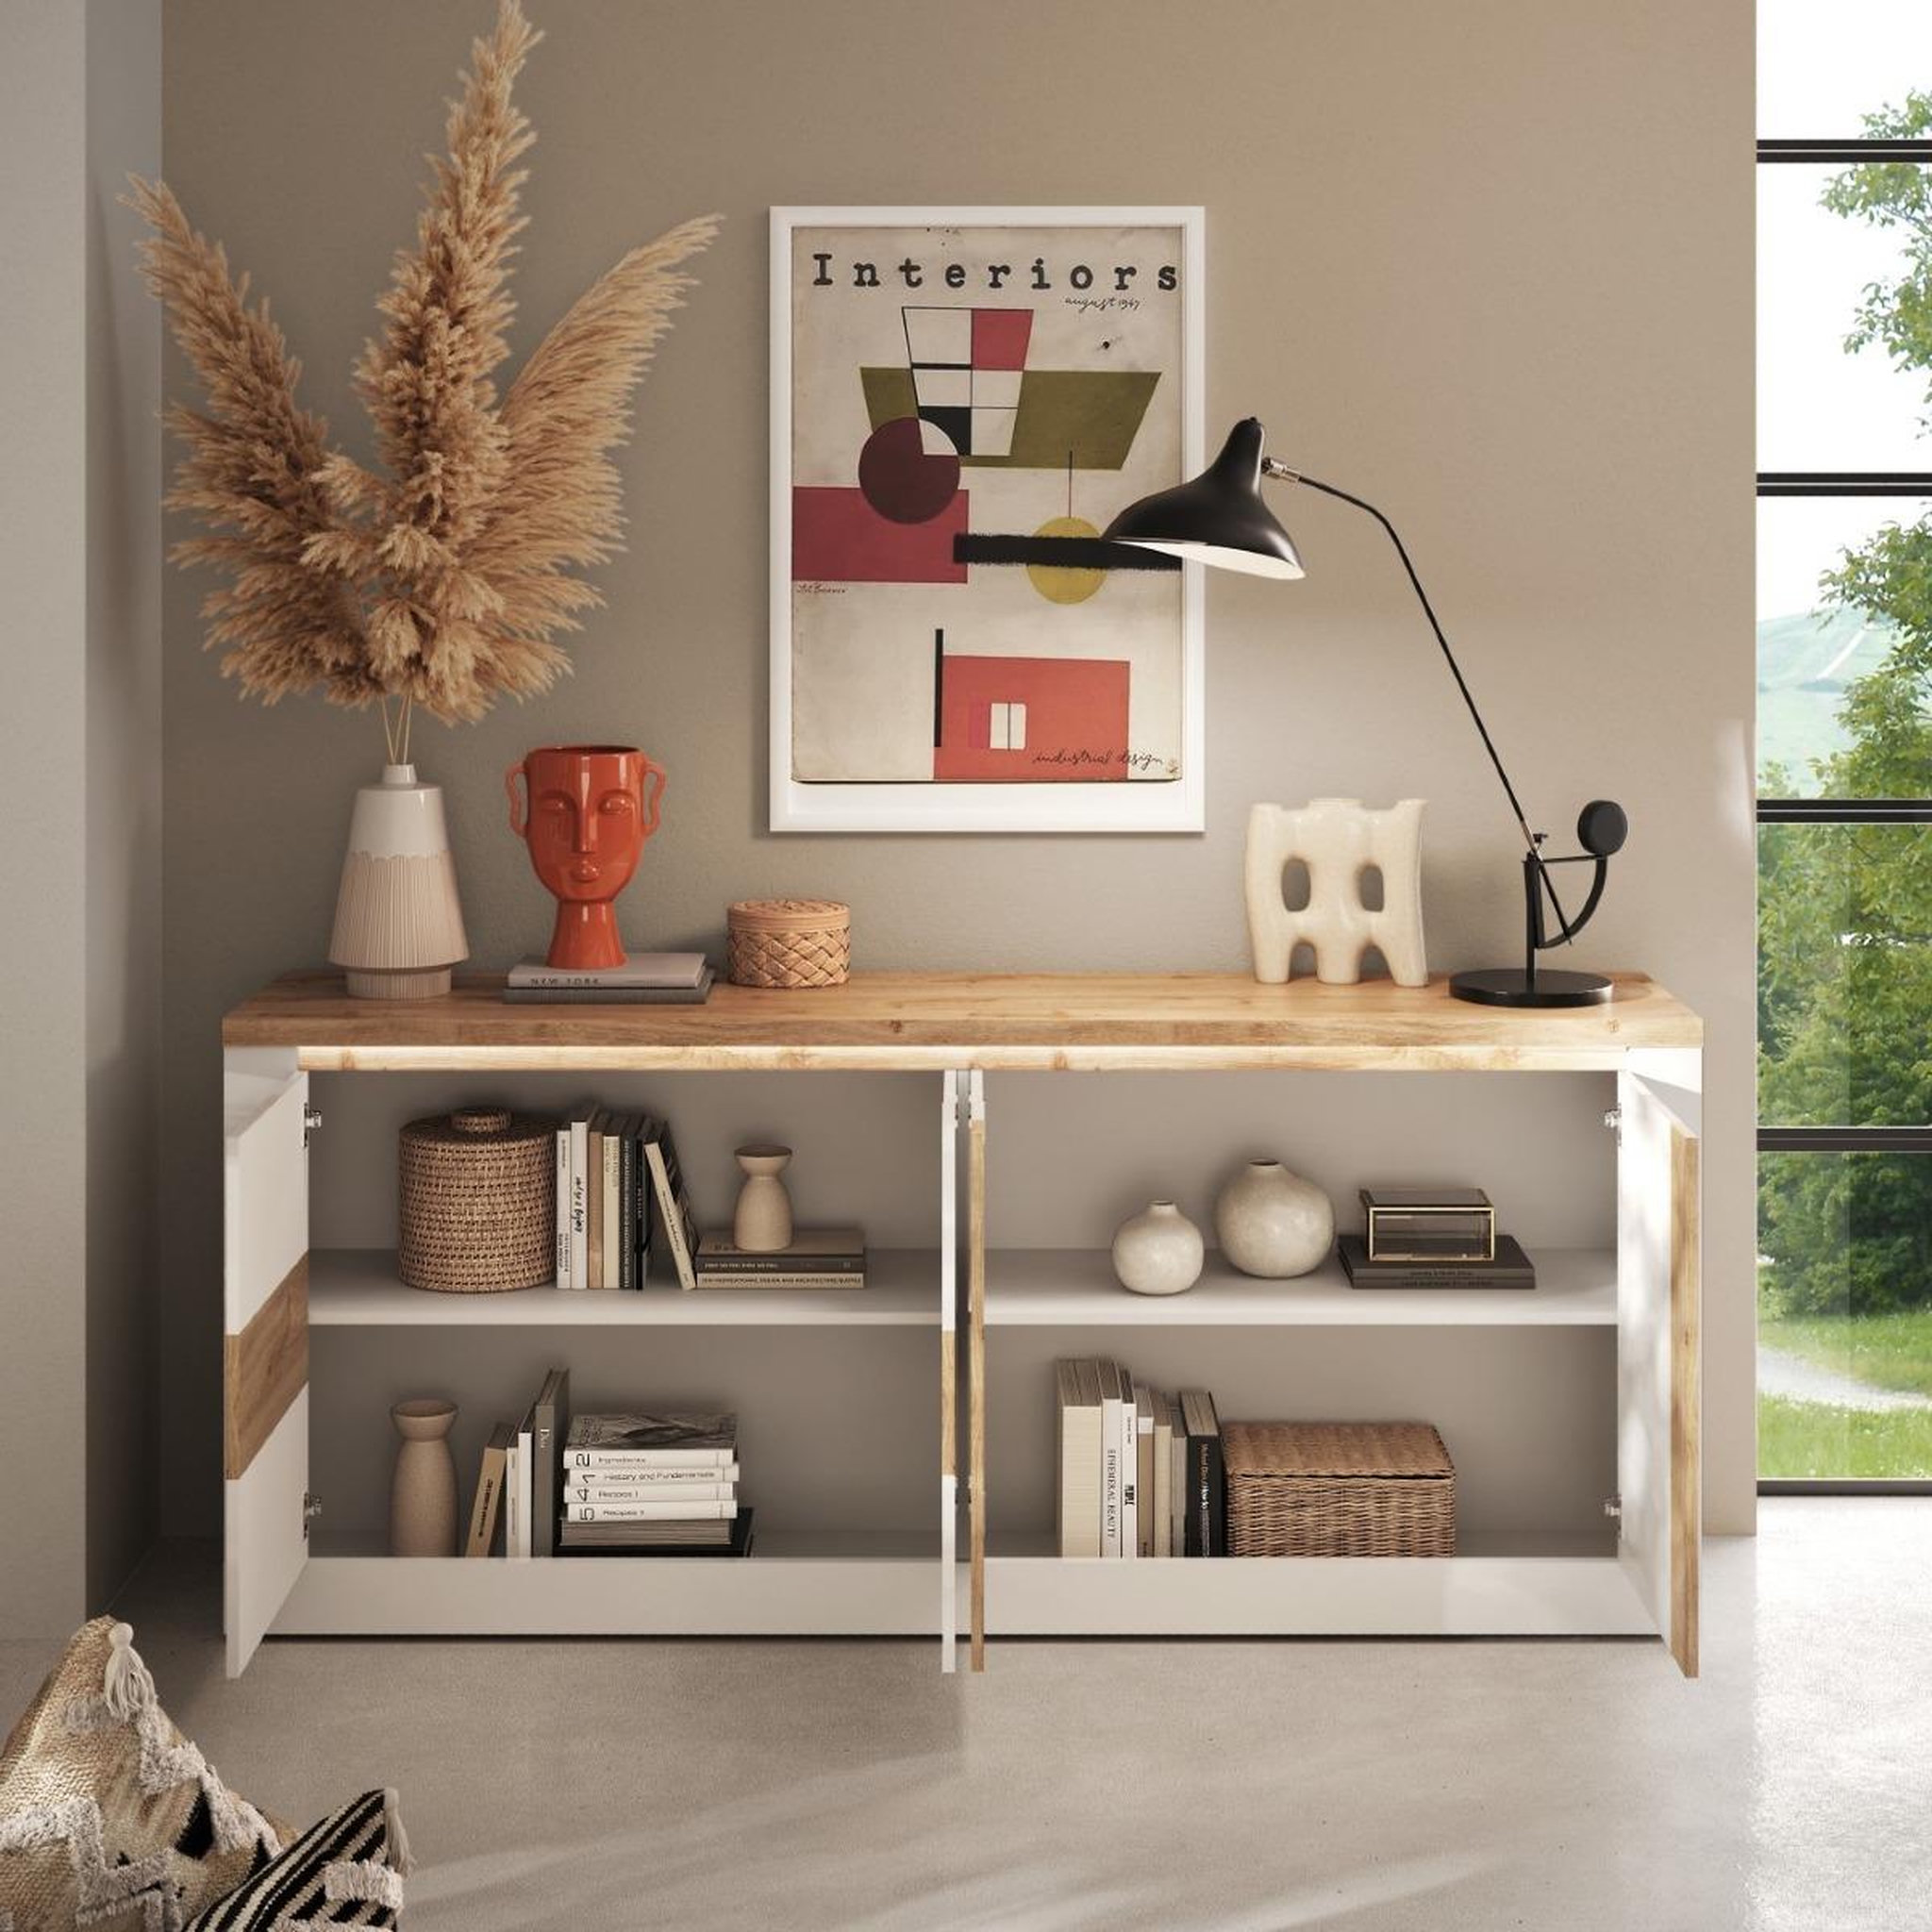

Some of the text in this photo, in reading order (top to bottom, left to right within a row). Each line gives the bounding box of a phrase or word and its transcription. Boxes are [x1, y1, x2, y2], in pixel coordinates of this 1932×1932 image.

[812, 253, 1177, 291] Interiors
[1064, 296, 1115, 313] august
[1032, 748, 1163, 771] industrial design
[575, 1453, 591, 1467] 2
[604, 1474, 637, 1482] History
[576, 1488, 590, 1501] 4
[1107, 1449, 1116, 1539] EPHEMERAL BEAUTY
[579, 1507, 595, 1521] 5
